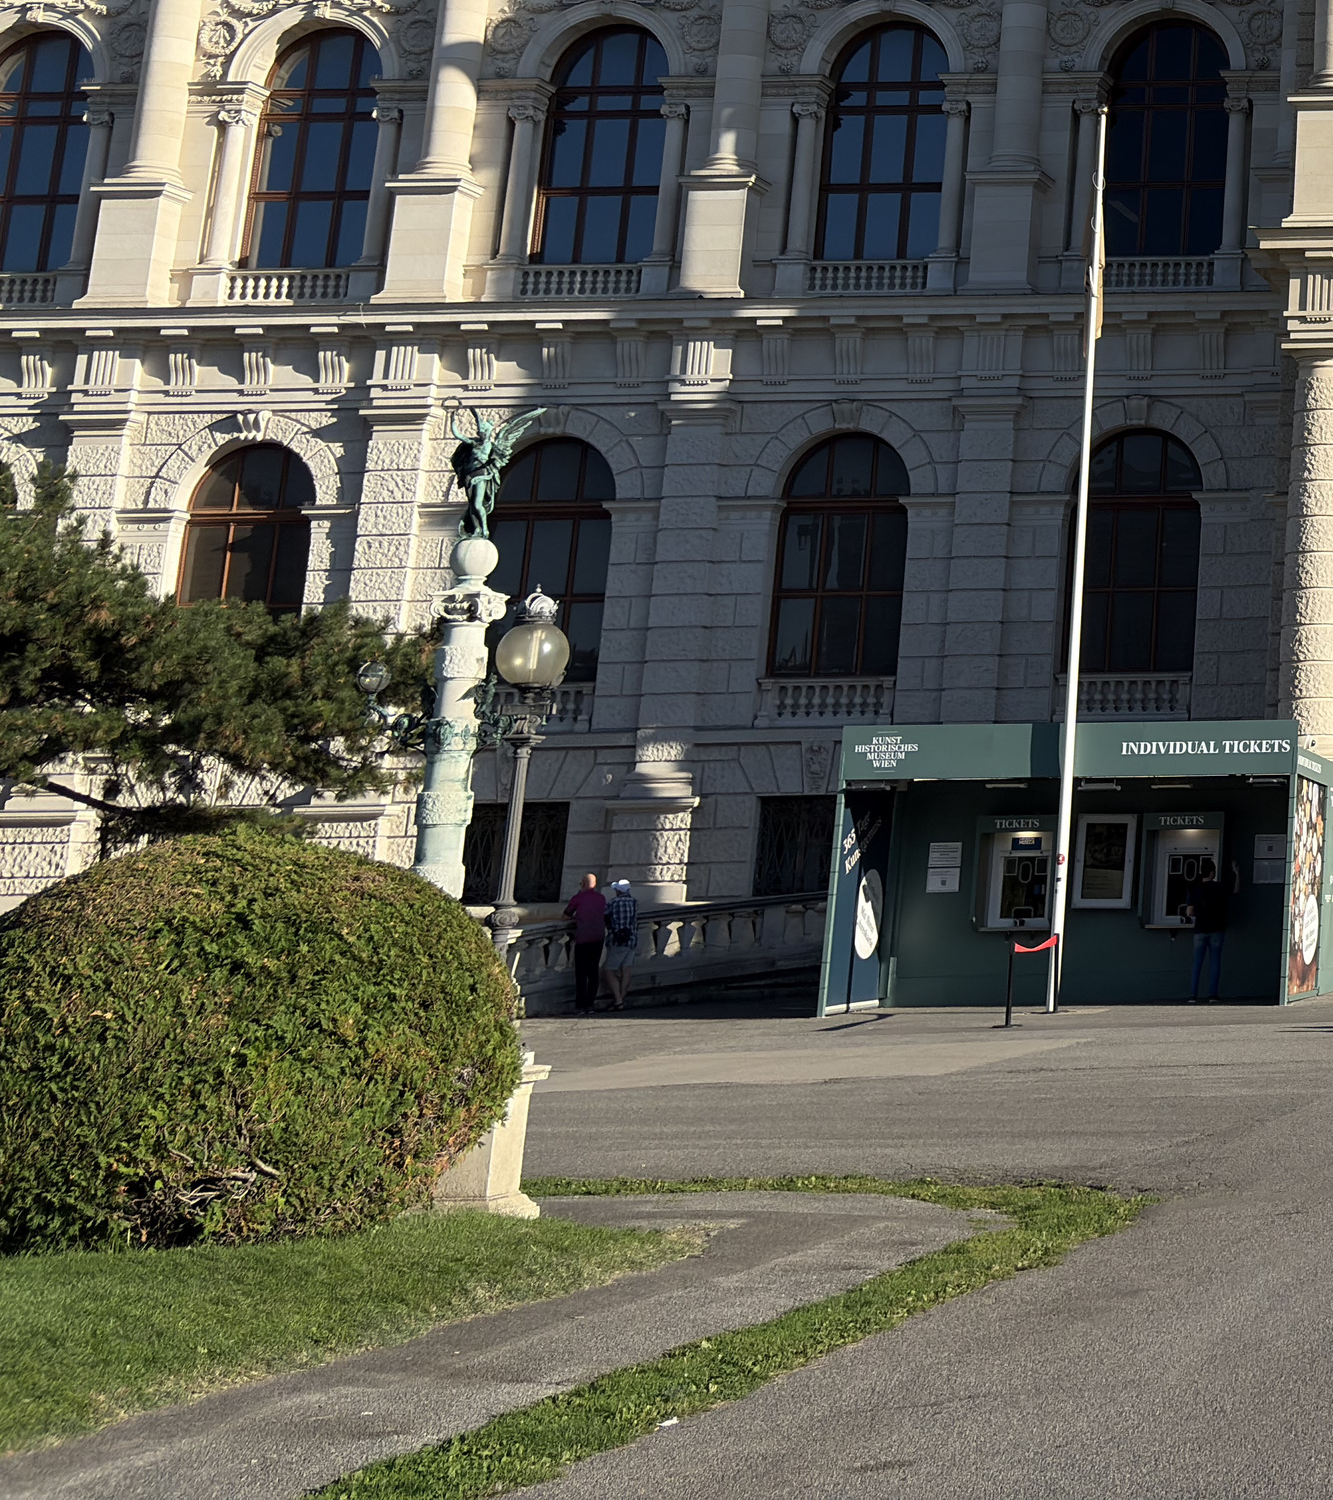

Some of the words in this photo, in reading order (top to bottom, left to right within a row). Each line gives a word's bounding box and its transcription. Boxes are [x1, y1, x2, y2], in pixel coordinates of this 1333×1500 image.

[872, 736, 902, 745] KUNST
[854, 743, 919, 753] HISTORISCHES
[1121, 740, 1219, 755] INDIVIDUAL
[1222, 739, 1291, 754] TICKETS
[866, 752, 906, 760] MUSEUM
[872, 760, 897, 768] WIEN
[994, 818, 1040, 829] TICKETS
[1159, 815, 1204, 826] TICKETS
[843, 828, 856, 854] 365
